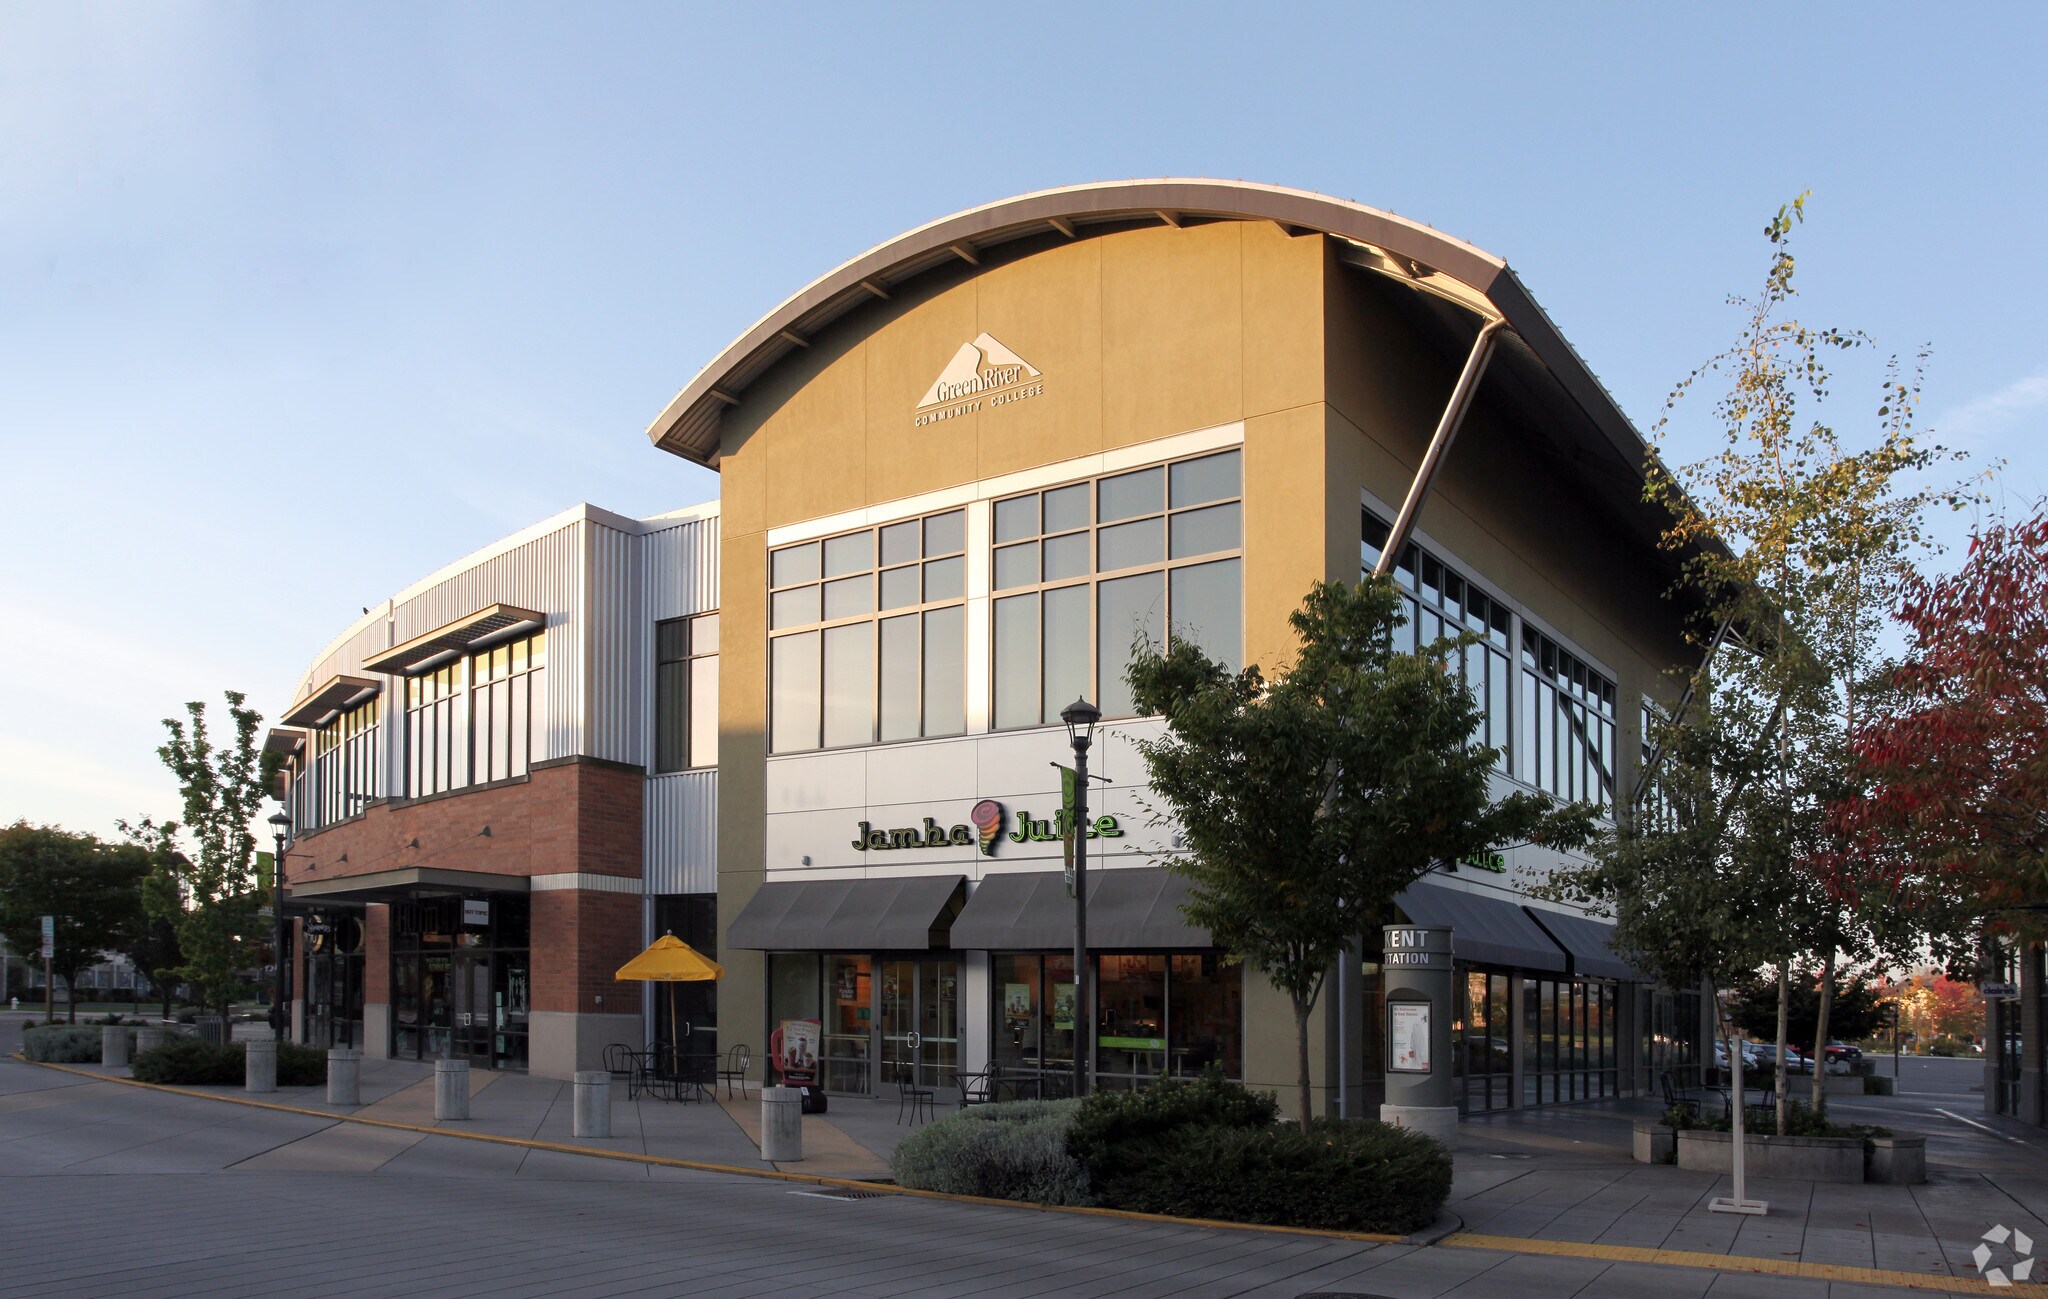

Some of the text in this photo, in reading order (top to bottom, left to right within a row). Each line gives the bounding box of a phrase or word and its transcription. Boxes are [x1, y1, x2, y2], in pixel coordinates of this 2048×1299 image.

[937, 365, 1023, 403] Green River
[915, 384, 1044, 428] COMMUNITY COLLEGE
[851, 808, 1125, 851] Jamba Juie
[1384, 930, 1429, 948] KENT
